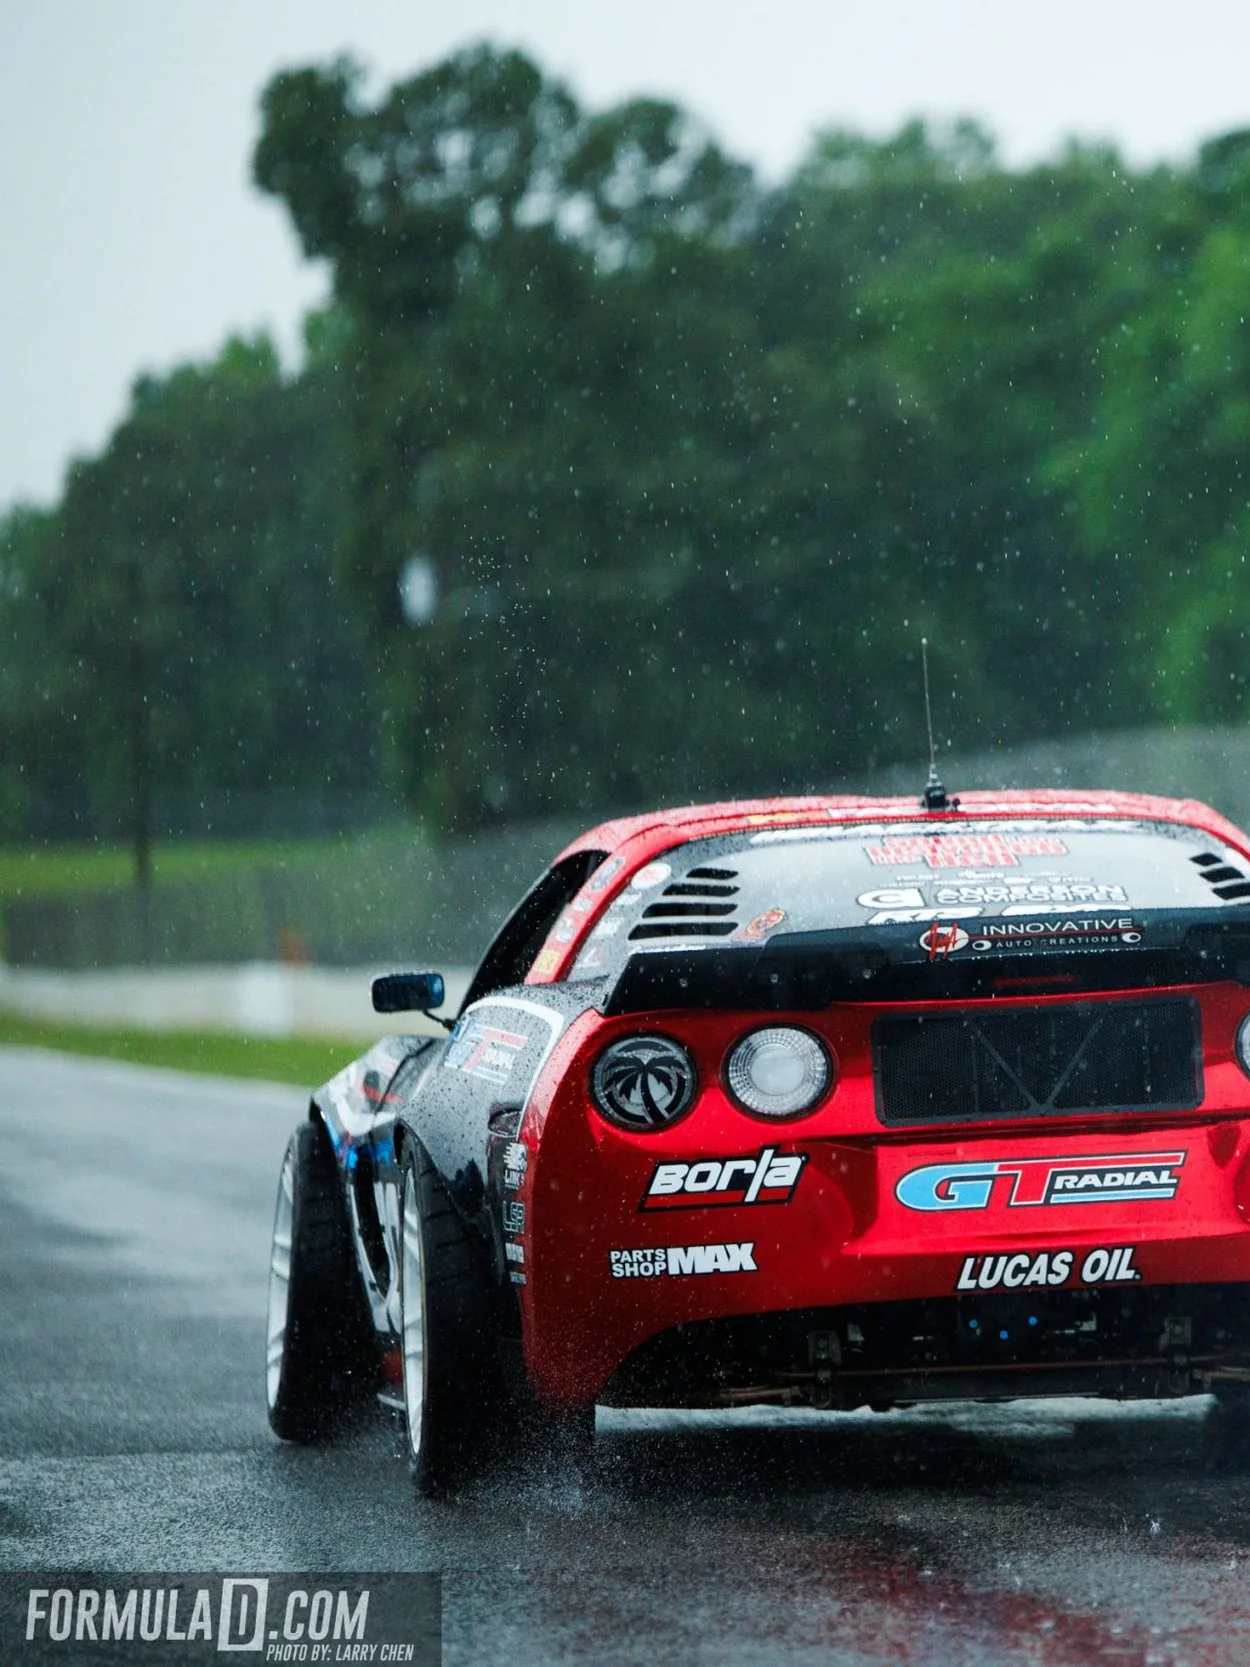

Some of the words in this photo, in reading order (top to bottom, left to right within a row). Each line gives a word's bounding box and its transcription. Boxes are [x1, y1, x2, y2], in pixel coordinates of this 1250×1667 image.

[983, 918, 1133, 936] INNOVATIVE
[996, 939, 1032, 949] AUTO
[895, 1151, 1187, 1211] GT
[1053, 1170, 1179, 1190] RADIAL
[610, 1249, 666, 1264] PARTS
[612, 1262, 667, 1278] SHOP
[667, 1243, 758, 1275] MAX
[957, 1252, 1074, 1290] LUCAS
[1082, 1248, 1137, 1284] OIL
